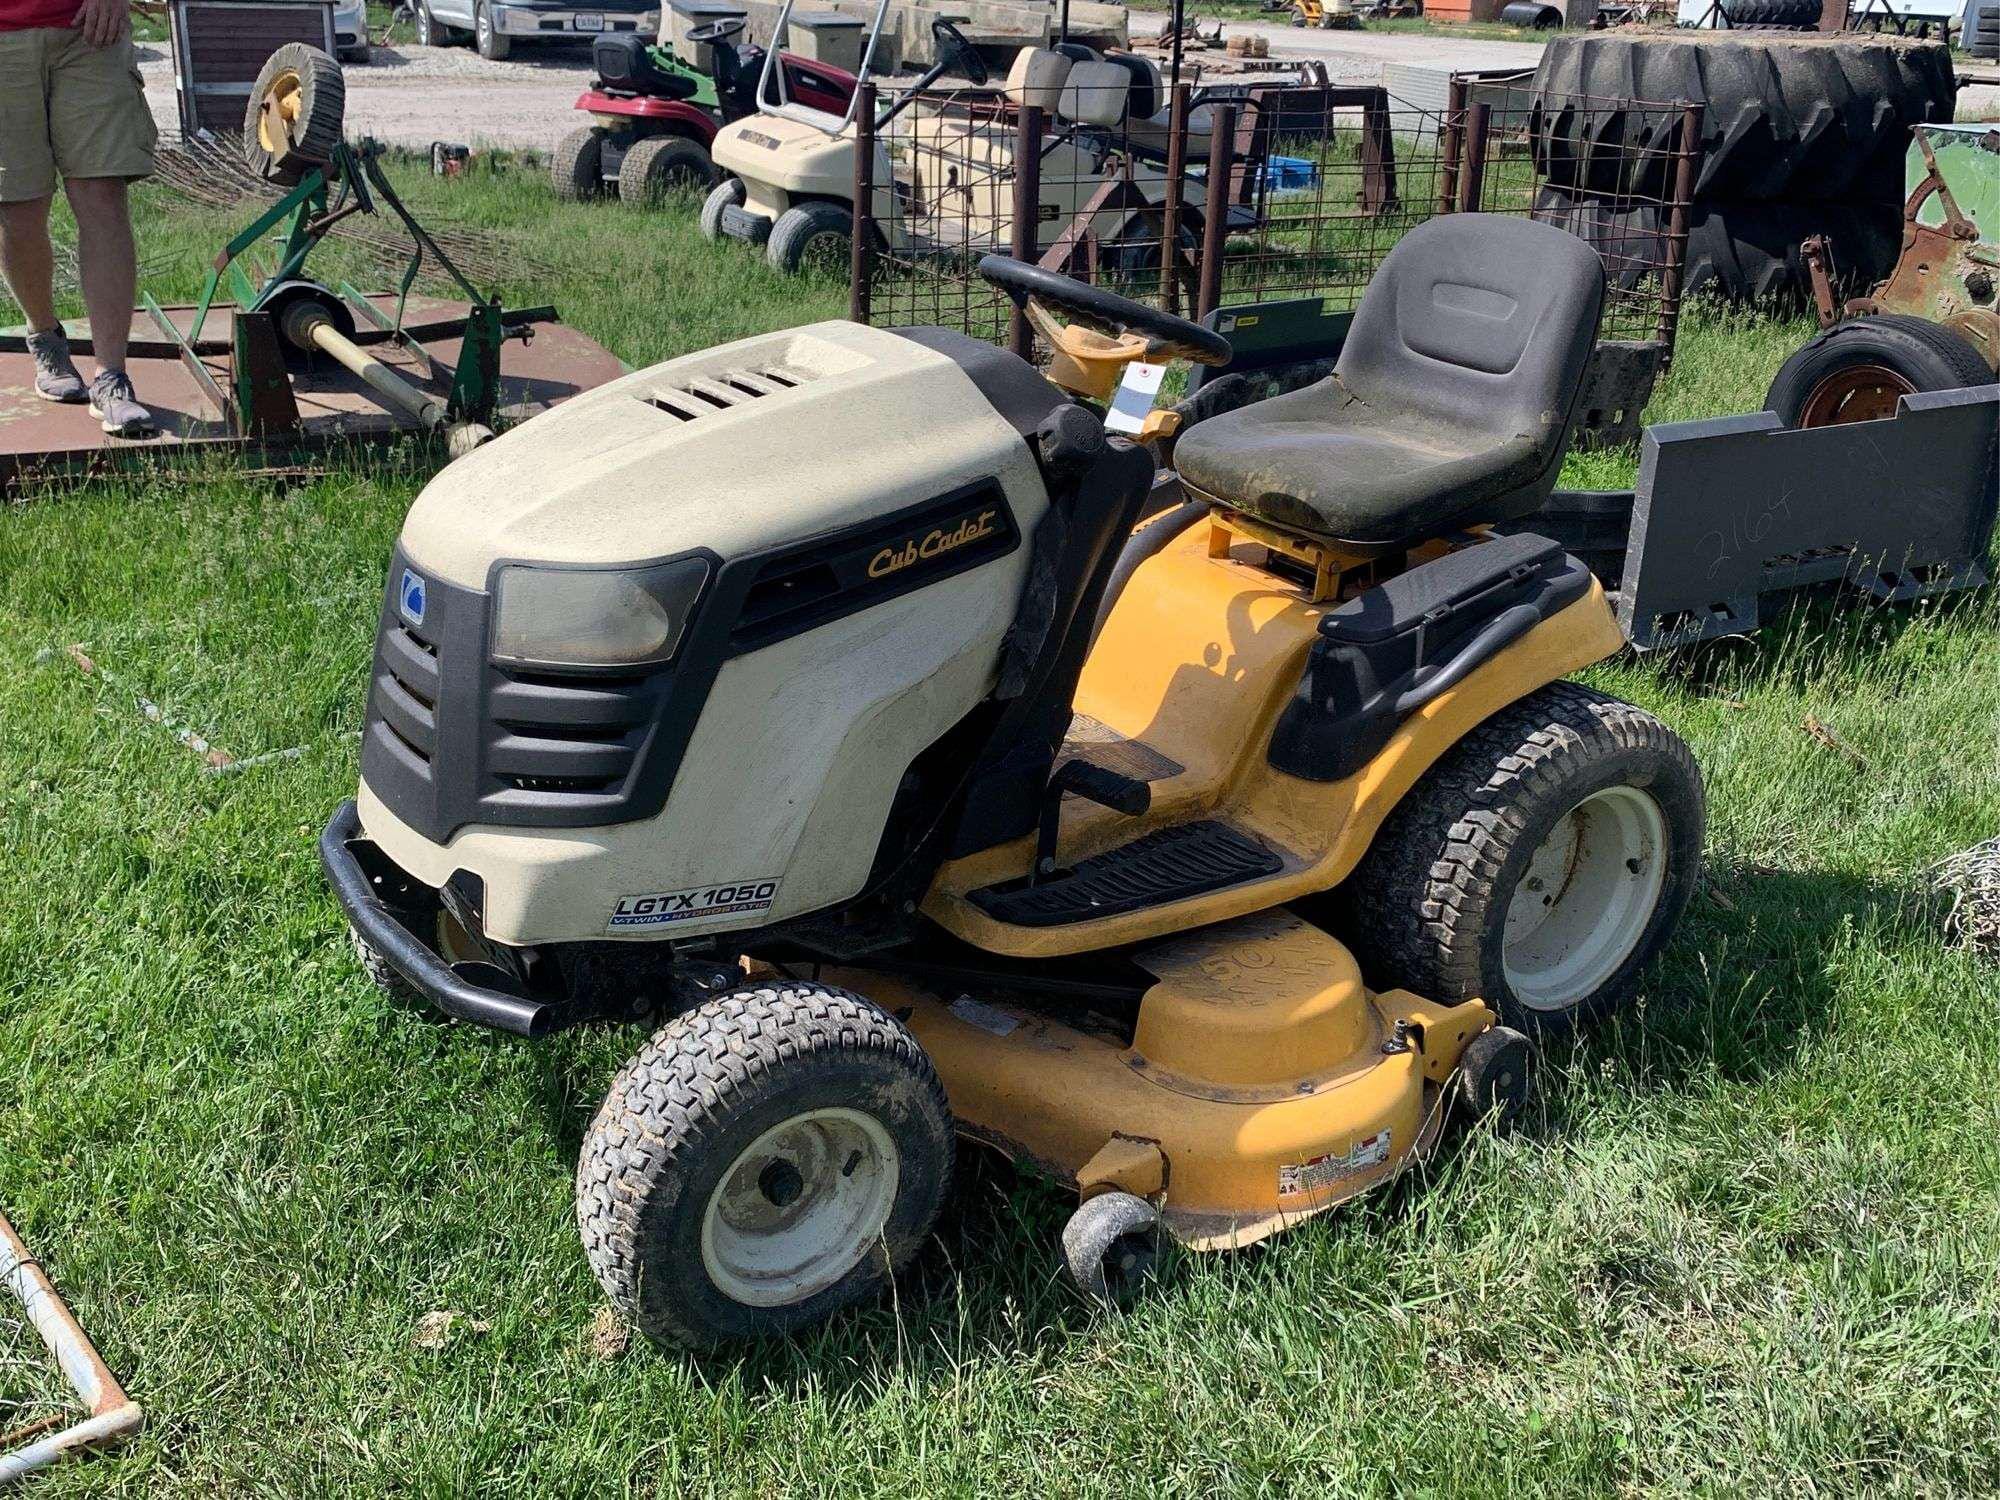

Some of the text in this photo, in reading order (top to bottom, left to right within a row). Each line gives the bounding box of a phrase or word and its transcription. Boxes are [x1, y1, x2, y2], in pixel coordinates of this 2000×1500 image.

[867, 510, 996, 578] Cub Cadet
[613, 901, 770, 925] V-TWIN HYDROSTATIC
[615, 883, 776, 916] LGTX 1050
